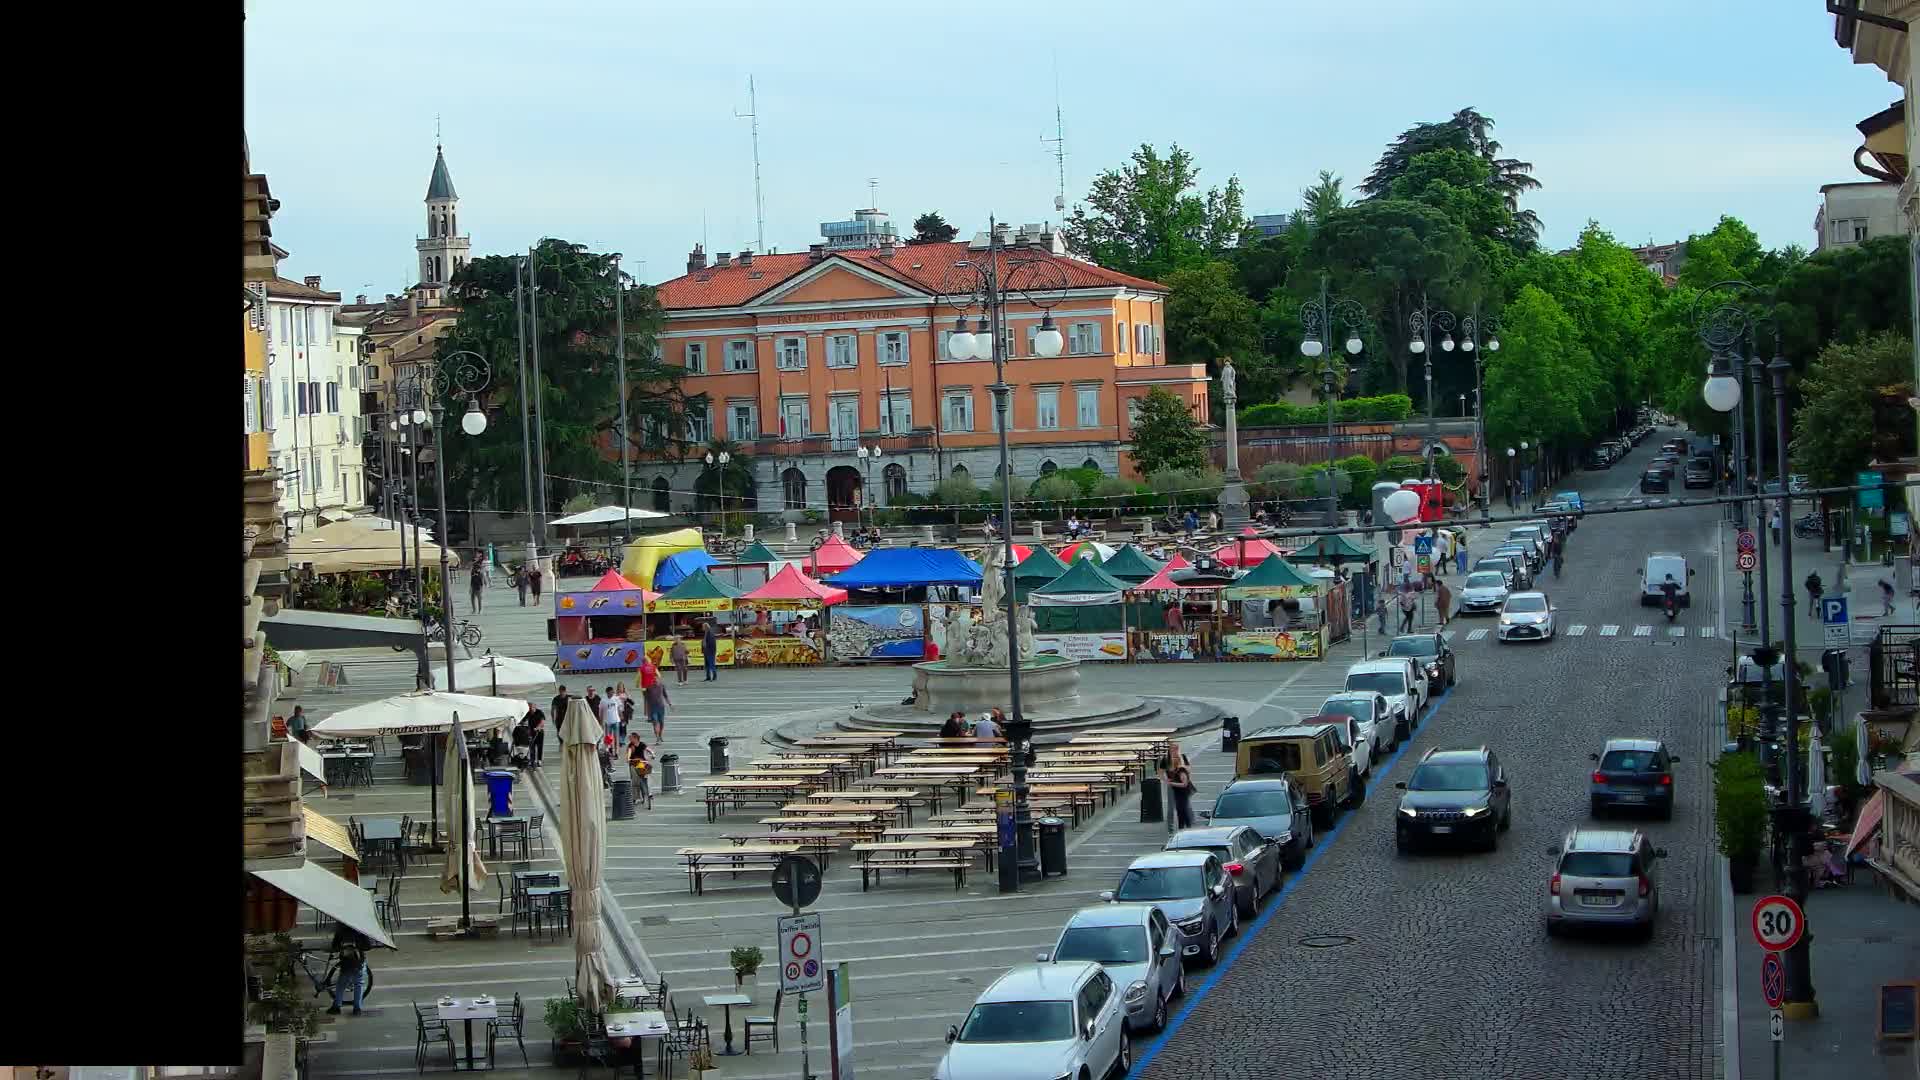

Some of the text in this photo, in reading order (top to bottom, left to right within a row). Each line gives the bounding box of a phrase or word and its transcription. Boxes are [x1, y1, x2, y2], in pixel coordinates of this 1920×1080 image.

[1742, 556, 1753, 566] 20
[1827, 601, 1842, 621] P
[1762, 911, 1791, 937] 30
[789, 967, 799, 976] 10
